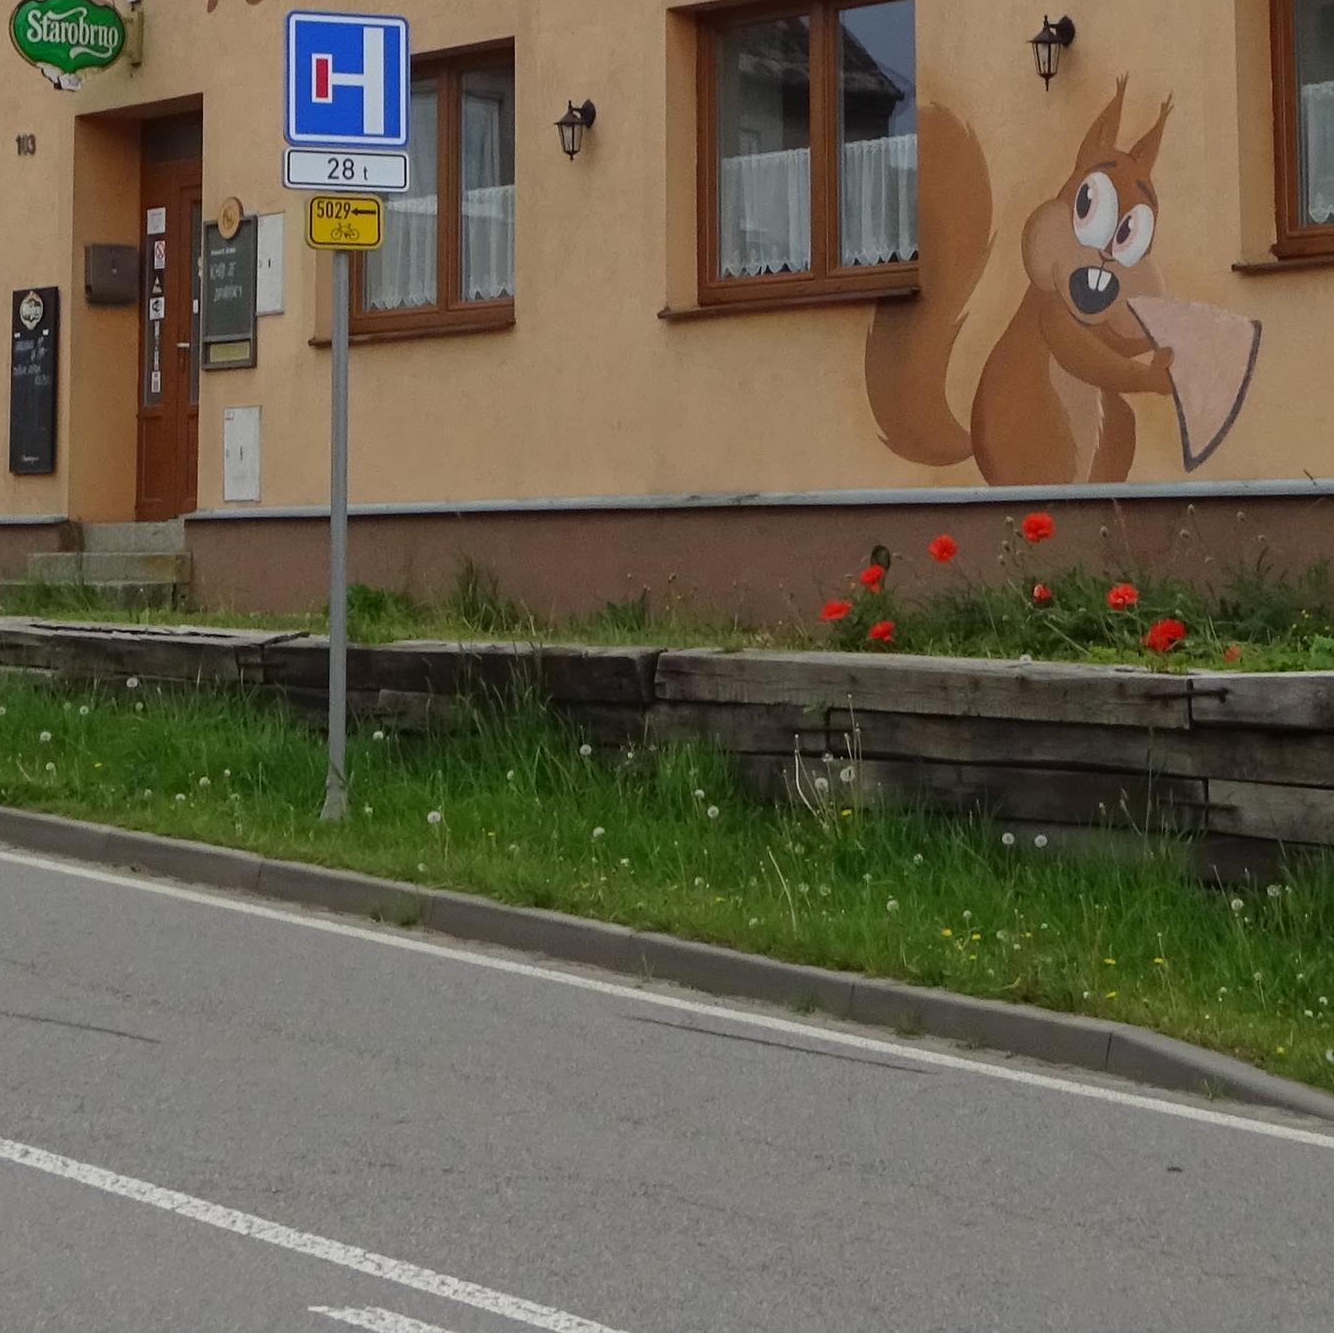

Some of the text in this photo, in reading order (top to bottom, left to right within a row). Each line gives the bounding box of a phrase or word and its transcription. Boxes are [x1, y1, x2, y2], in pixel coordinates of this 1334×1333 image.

[27, 7, 119, 59] Starobrno
[327, 157, 369, 180] 28 t
[317, 200, 351, 219] 5029
